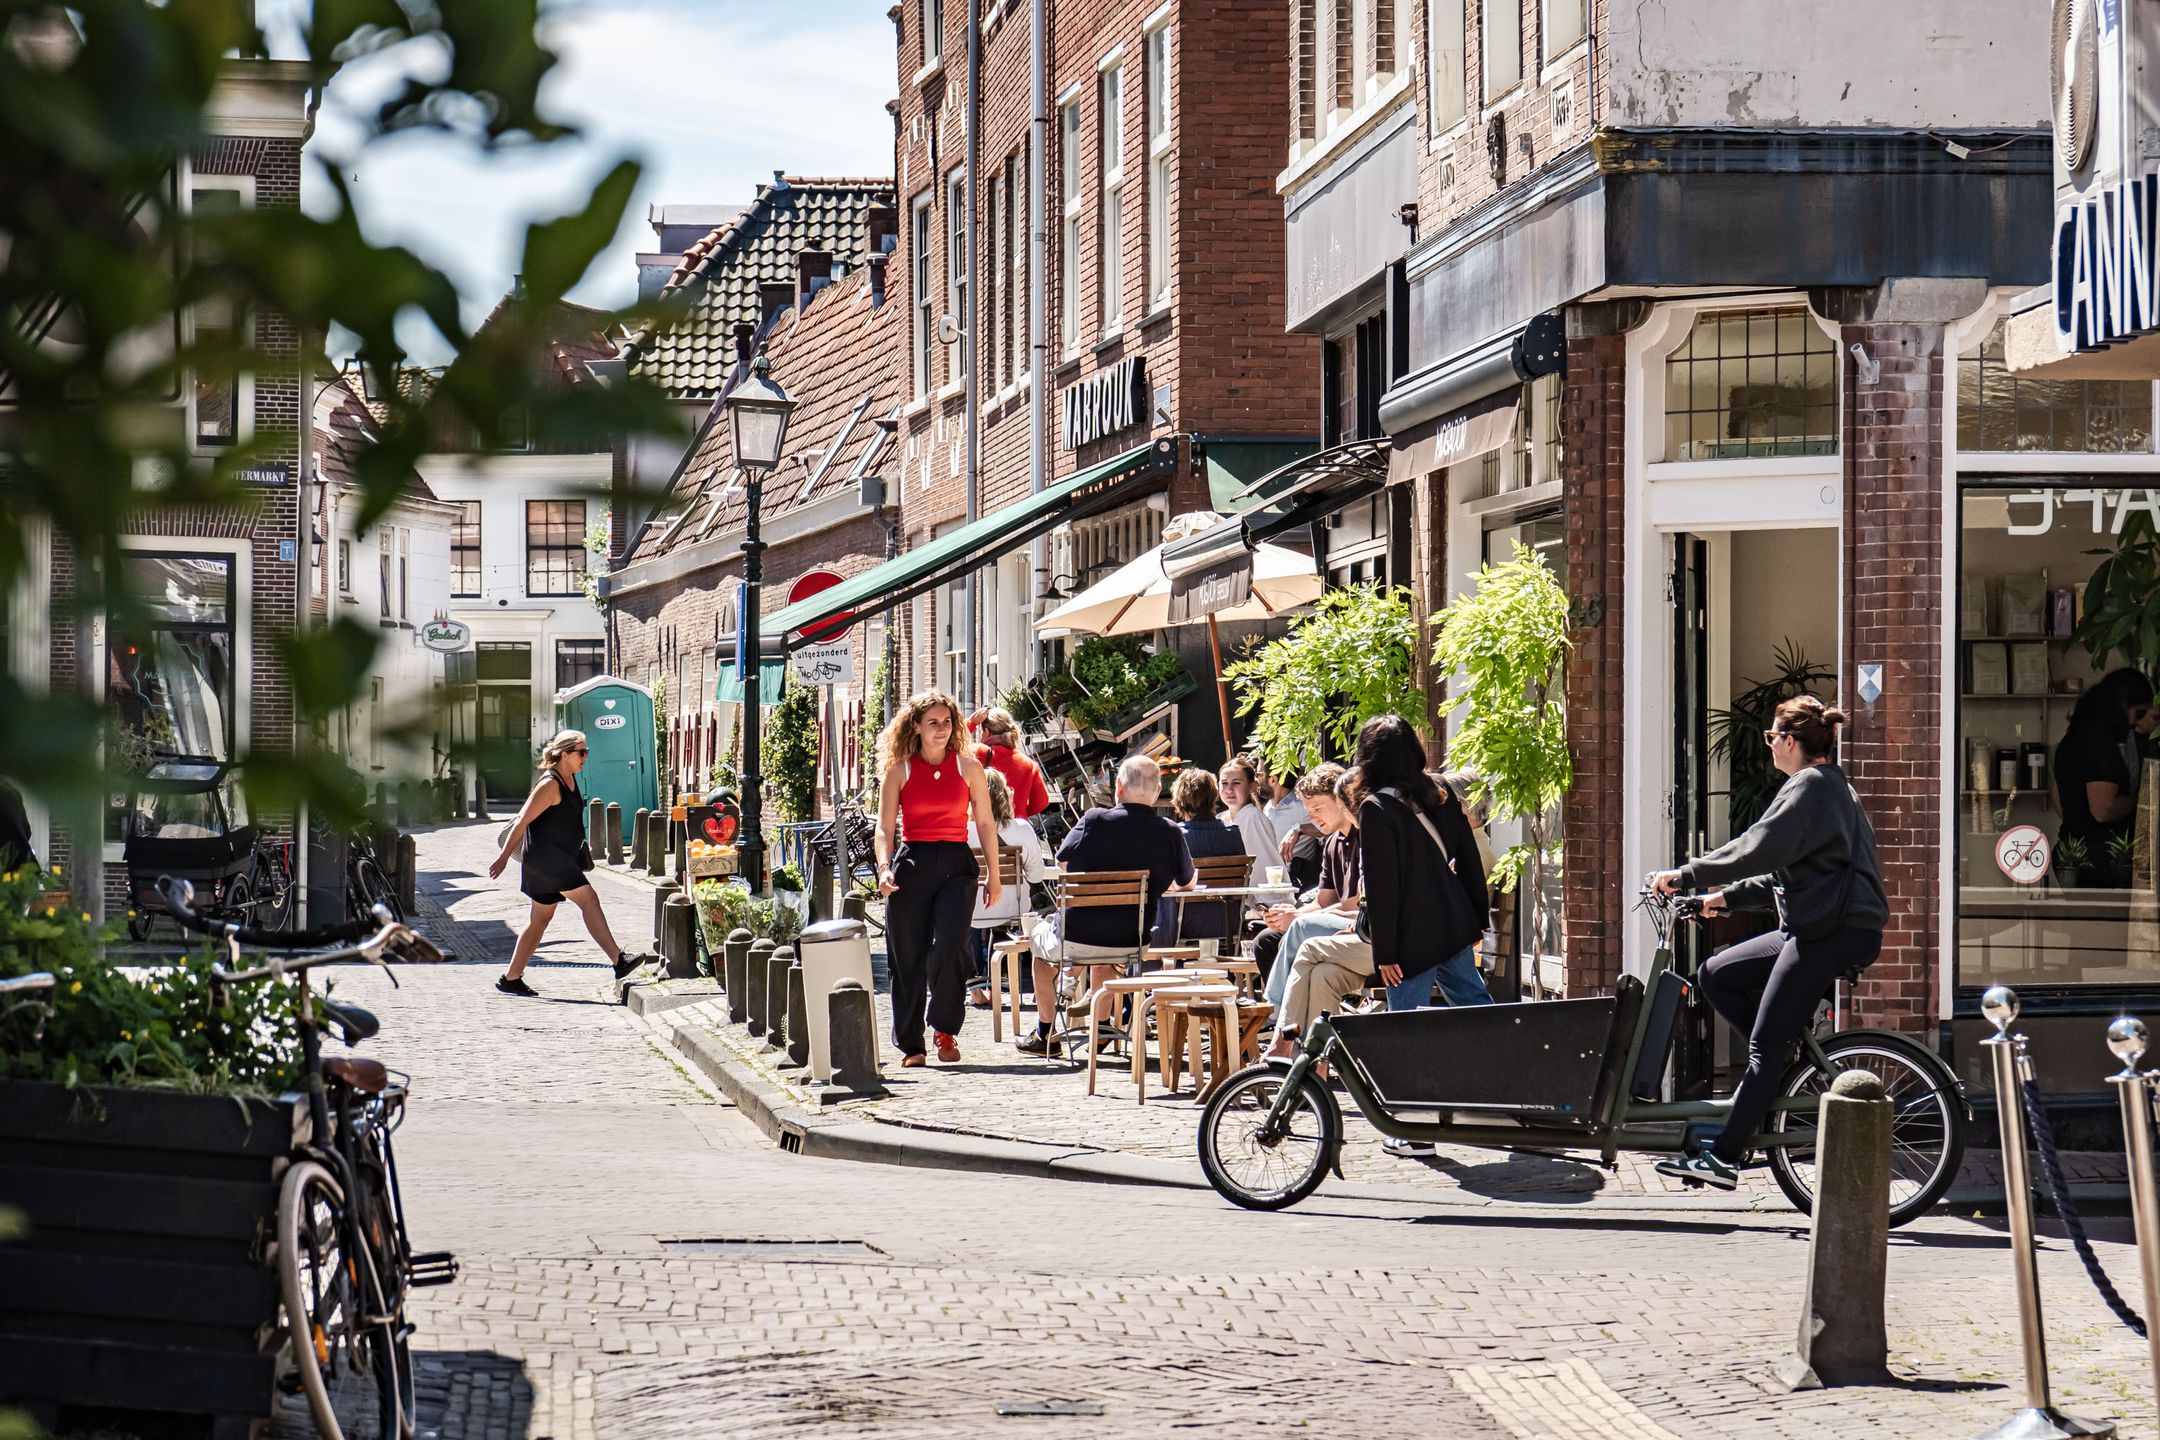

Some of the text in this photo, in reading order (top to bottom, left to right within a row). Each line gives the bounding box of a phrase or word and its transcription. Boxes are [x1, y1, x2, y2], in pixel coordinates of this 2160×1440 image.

[1062, 356, 1135, 451] MABROUK
[427, 627, 463, 642] Grolsch
[796, 647, 848, 660] uitgezonderd
